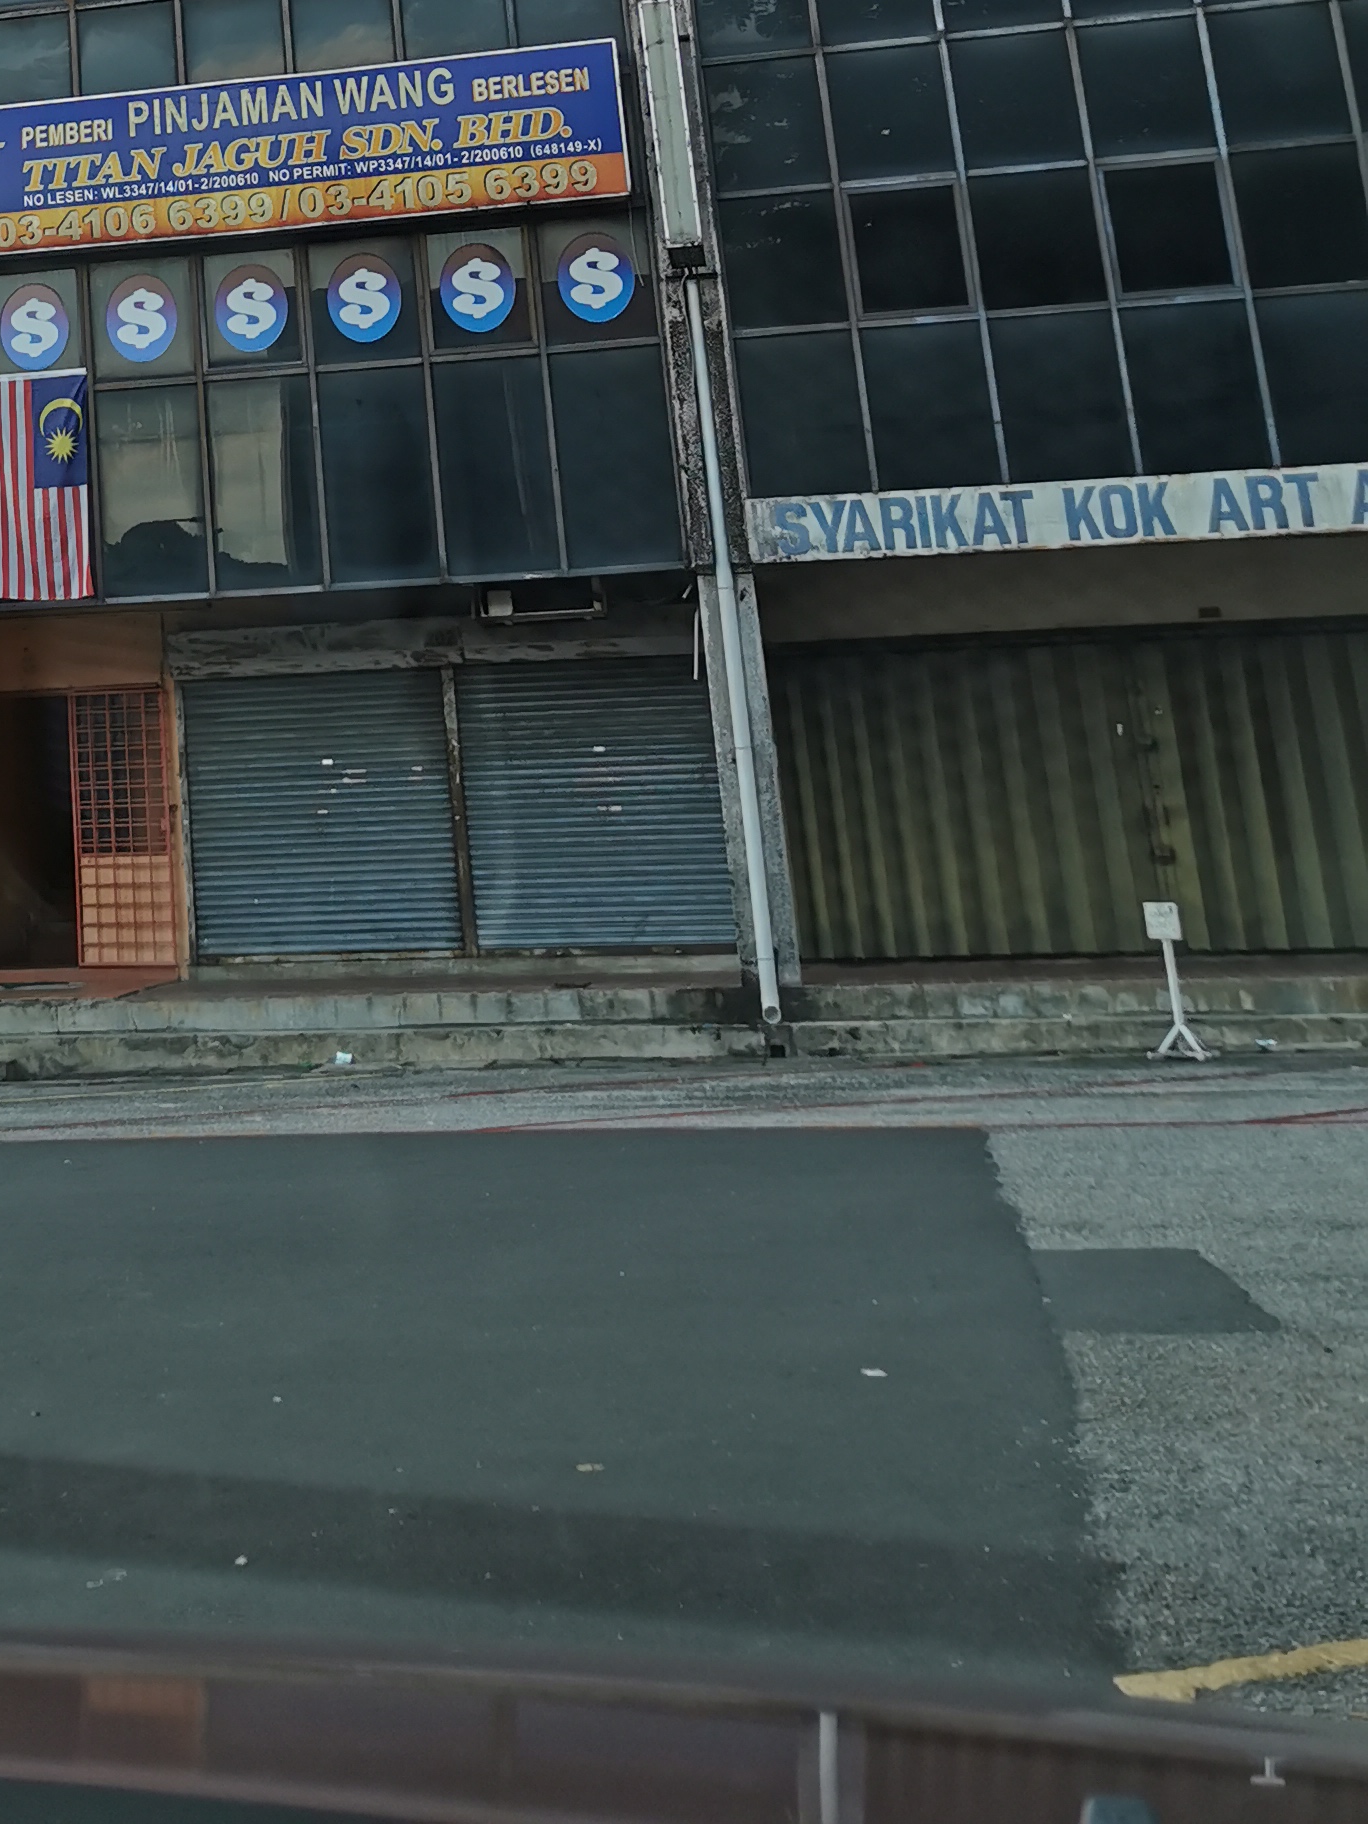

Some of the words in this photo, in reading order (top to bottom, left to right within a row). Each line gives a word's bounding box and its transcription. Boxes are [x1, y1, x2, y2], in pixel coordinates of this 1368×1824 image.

[21, 118, 114, 150] PEMBERI
[128, 80, 324, 137] PINJAMAN
[333, 67, 455, 116] WANG
[471, 66, 591, 103] BERLESEN
[22, 146, 167, 192] TITAN
[172, 129, 330, 181] JAGUH
[340, 117, 443, 160] SDN.
[453, 106, 574, 149] BHD.
[23, 193, 44, 208] NO
[47, 188, 98, 206] LESEN:
[269, 169, 291, 183] NO
[293, 163, 352, 180] PERMIT:
[530, 137, 602, 159] (648149-X)
[167, 191, 274, 232] 6399
[298, 170, 473, 219] 03-4105
[483, 159, 599, 202] 6399
[774, 488, 1034, 555] SYARIKAT
[1062, 481, 1177, 542] KOK
[1208, 471, 1318, 534] ART
